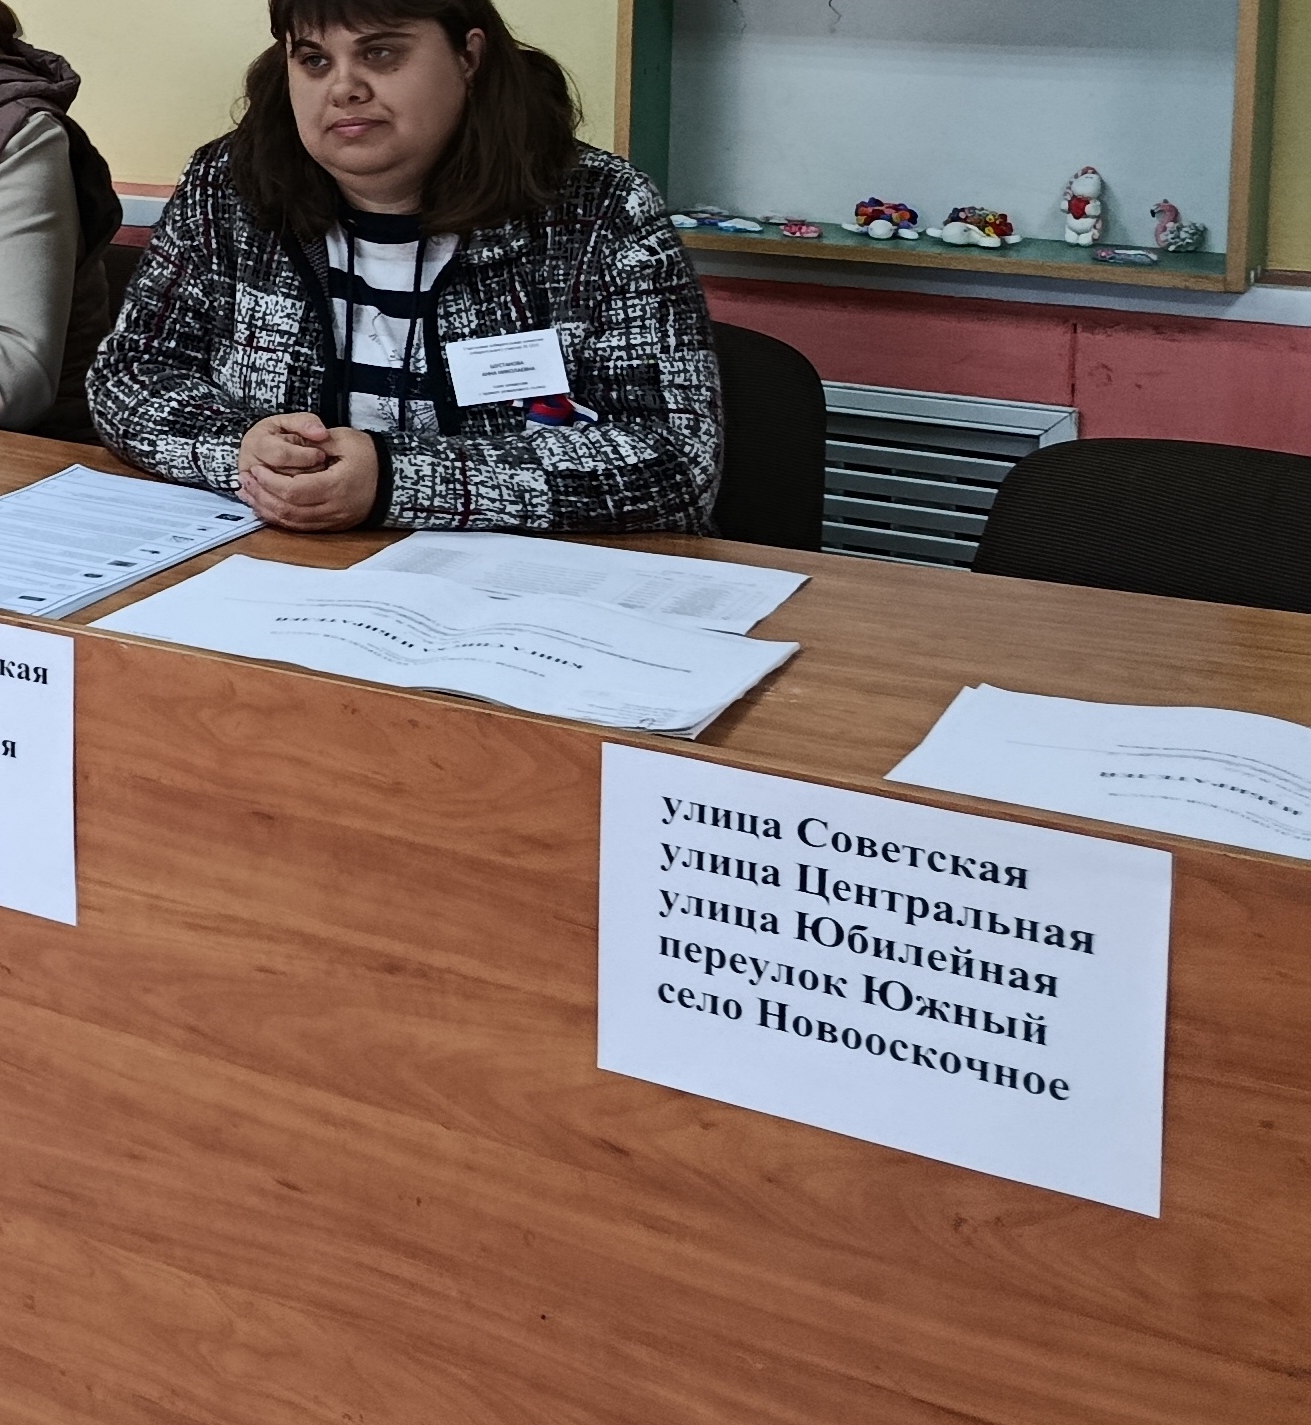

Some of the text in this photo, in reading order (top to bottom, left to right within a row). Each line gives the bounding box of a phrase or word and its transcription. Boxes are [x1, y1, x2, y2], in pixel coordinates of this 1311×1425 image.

[660, 841, 1096, 954] улица Центральная
[661, 795, 1029, 890] улица Советская
[658, 935, 1048, 1046] переулок Южный
[659, 888, 1058, 998] улица Юбилейная
[658, 980, 1071, 1102] село Новооскочное
